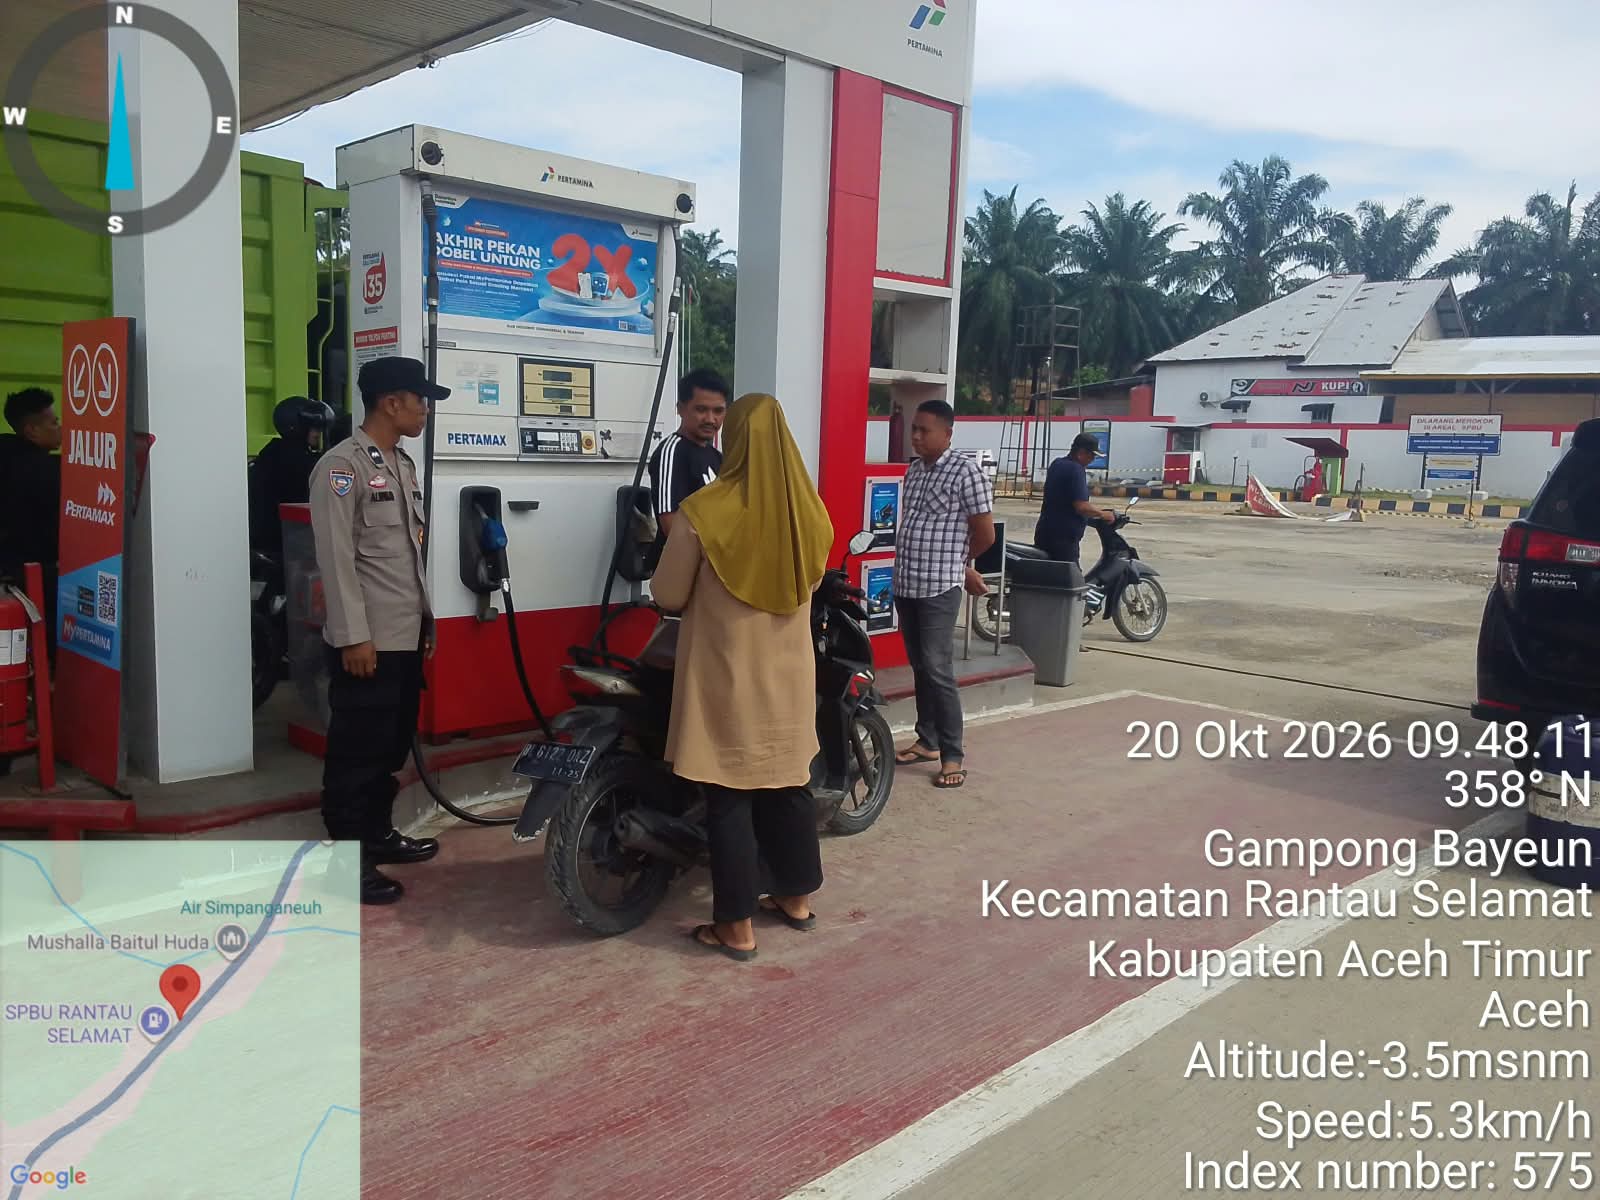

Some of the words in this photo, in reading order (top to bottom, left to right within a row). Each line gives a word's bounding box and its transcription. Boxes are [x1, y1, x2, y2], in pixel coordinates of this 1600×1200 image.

[907, 38, 943, 58] PERTAMINA
[557, 174, 594, 189] PERTAMINA
[487, 239, 541, 259] PEKAN
[480, 250, 541, 270] UNTUNG
[68, 429, 117, 470] JALUR
[447, 432, 507, 447] PERTAMAX
[65, 499, 115, 526] PERTAMAX
